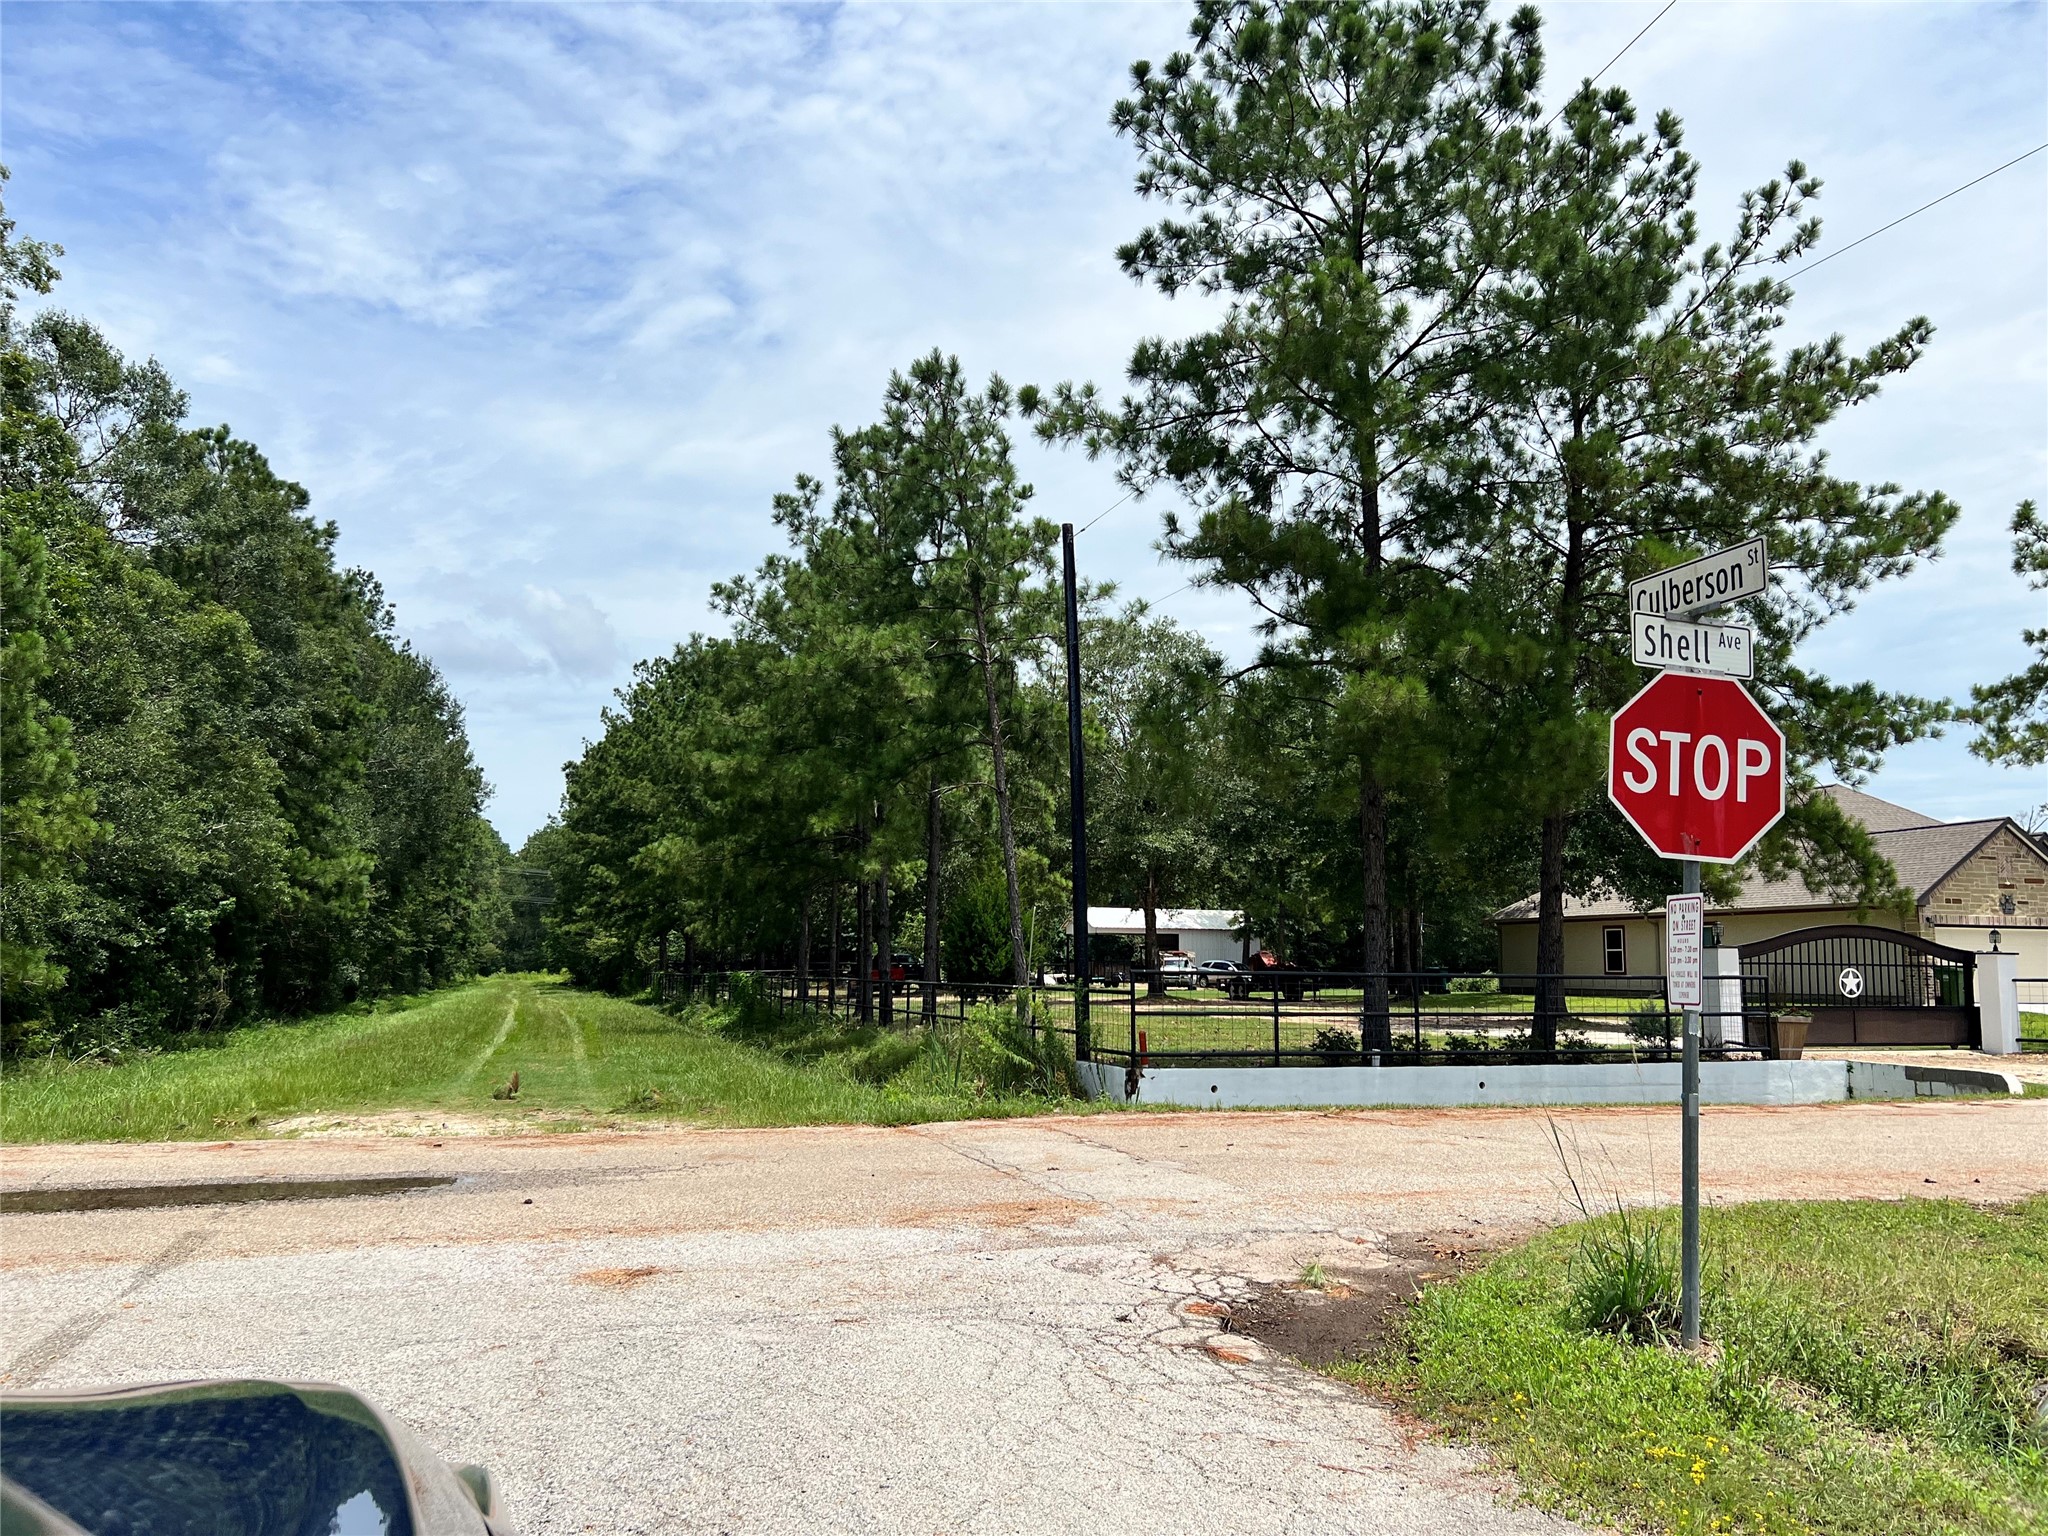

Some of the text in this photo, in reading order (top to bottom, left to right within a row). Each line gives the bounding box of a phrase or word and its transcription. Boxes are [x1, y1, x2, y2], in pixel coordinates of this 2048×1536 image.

[1637, 547, 1759, 613] Culberson St
[1644, 624, 1741, 664] Shell Ave
[1623, 727, 1771, 803] STOP
[1671, 902, 1698, 914] NO PARKING
[1673, 919, 1696, 931] ON STREET
